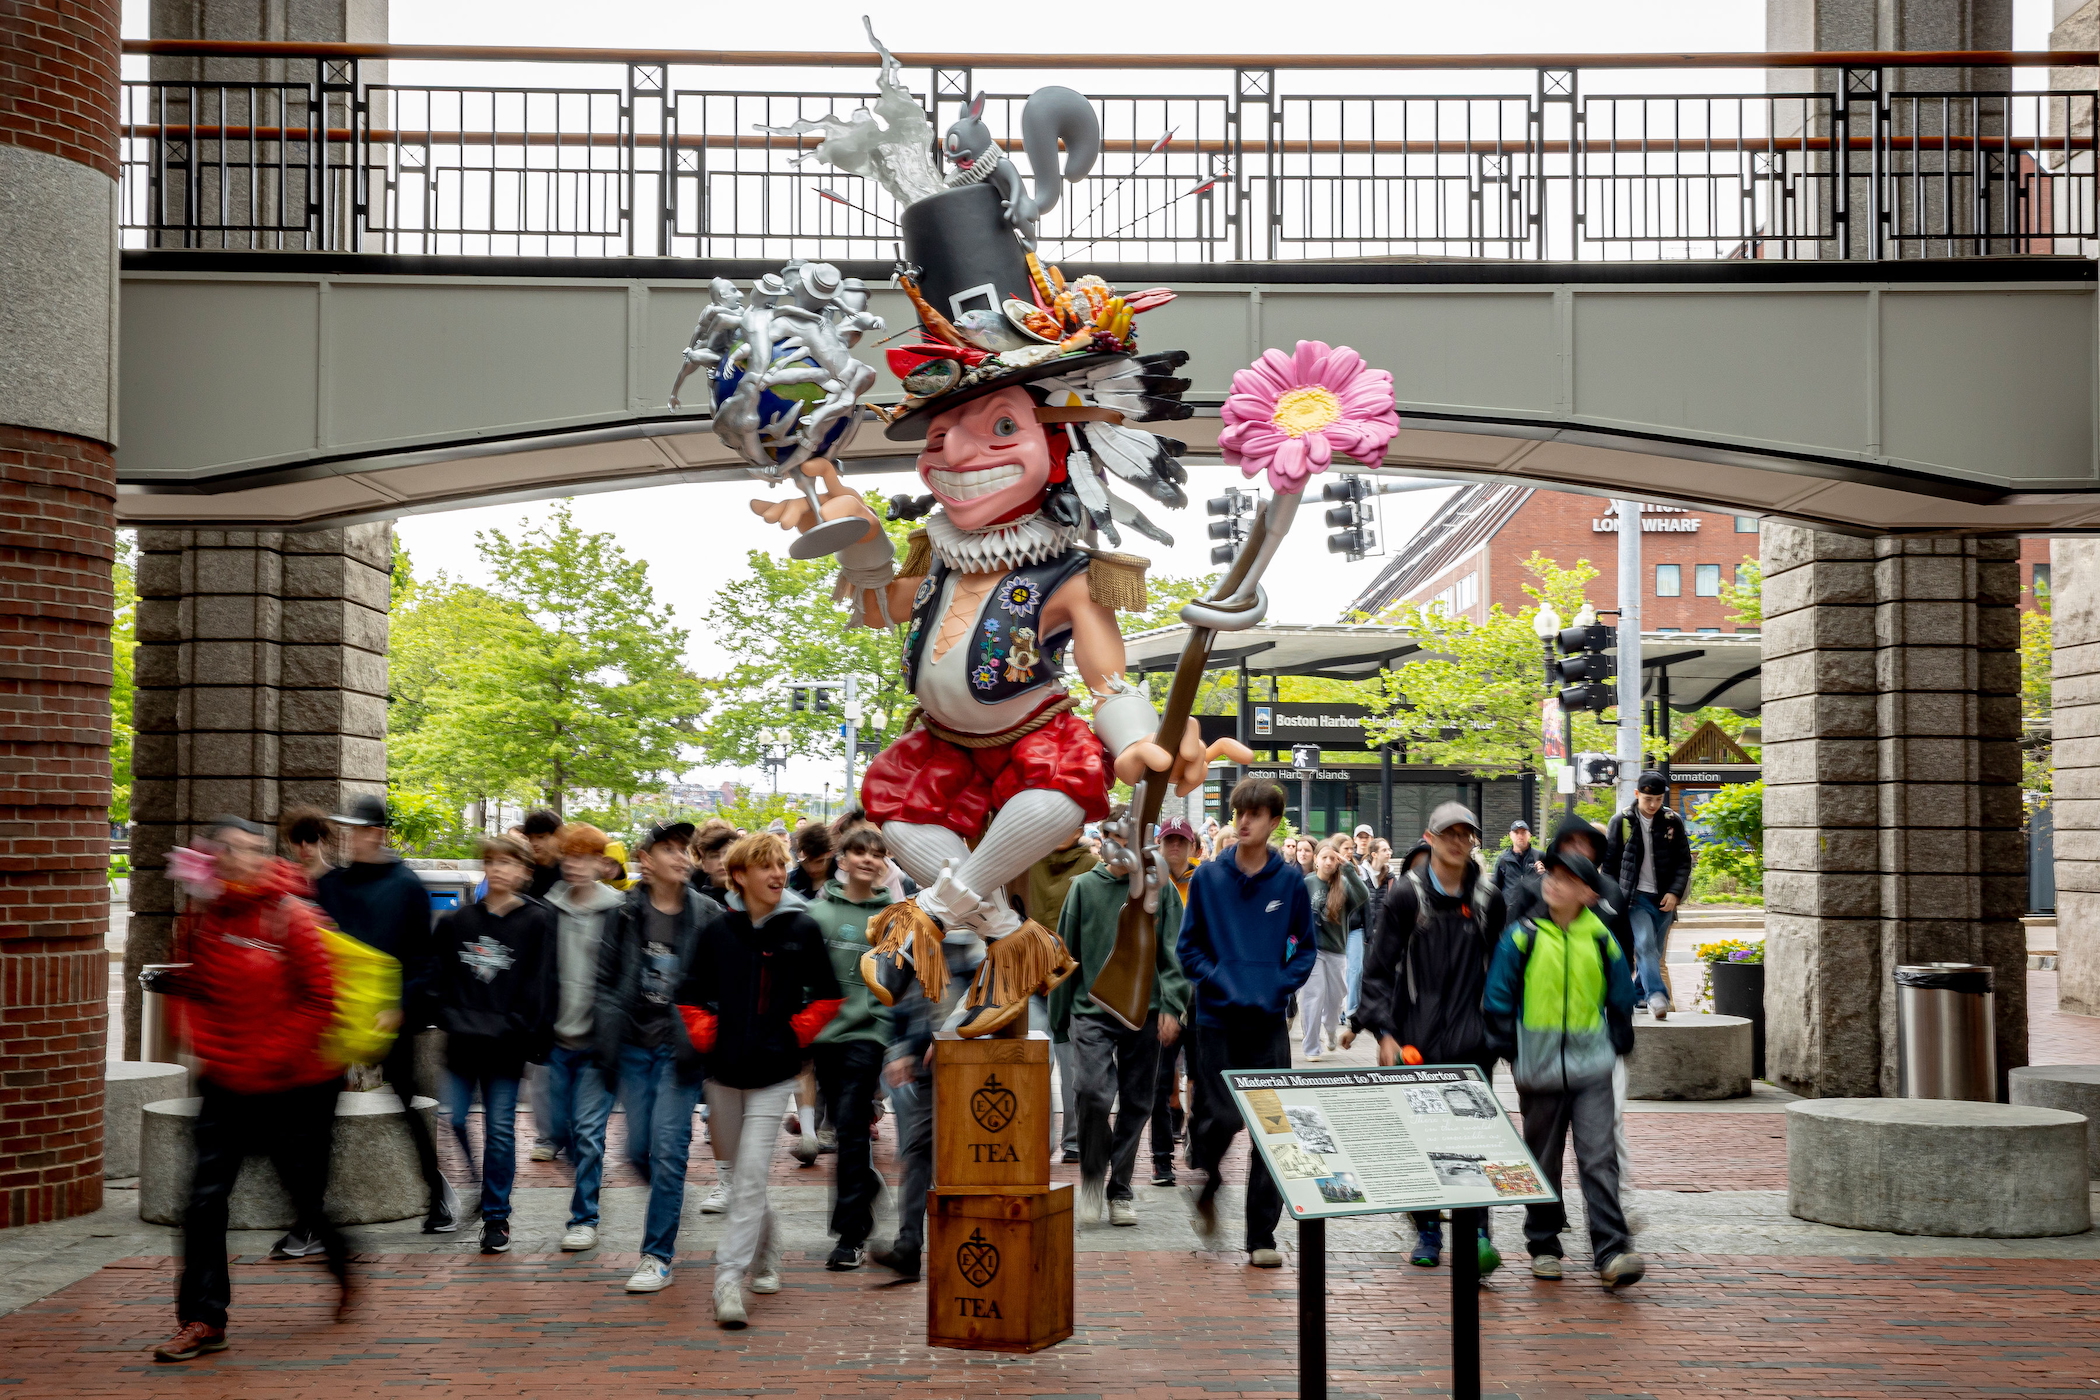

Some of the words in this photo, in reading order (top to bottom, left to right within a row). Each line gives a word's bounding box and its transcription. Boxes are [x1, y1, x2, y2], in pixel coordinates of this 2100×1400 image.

[1641, 518, 1702, 532] WHARF
[1276, 714, 1319, 727] Boston
[1320, 714, 1361, 728] Harbor
[1248, 769, 1277, 779] oston
[1279, 769, 1315, 780] Harbr
[1315, 769, 1350, 780] Islands
[1669, 771, 1721, 782] ormation
[1234, 1075, 1289, 1088] Material
[1290, 1073, 1353, 1087] Monument
[1354, 1074, 1369, 1085] to
[1367, 1072, 1416, 1084] Thomas
[1416, 1070, 1461, 1083] Morton
[976, 1100, 985, 1112] E
[1004, 1100, 1010, 1112] I
[967, 1143, 1021, 1163] TEA
[962, 1254, 971, 1266] E
[987, 1255, 993, 1268] I
[972, 1269, 983, 1282] C
[954, 1296, 1004, 1320] TEA
